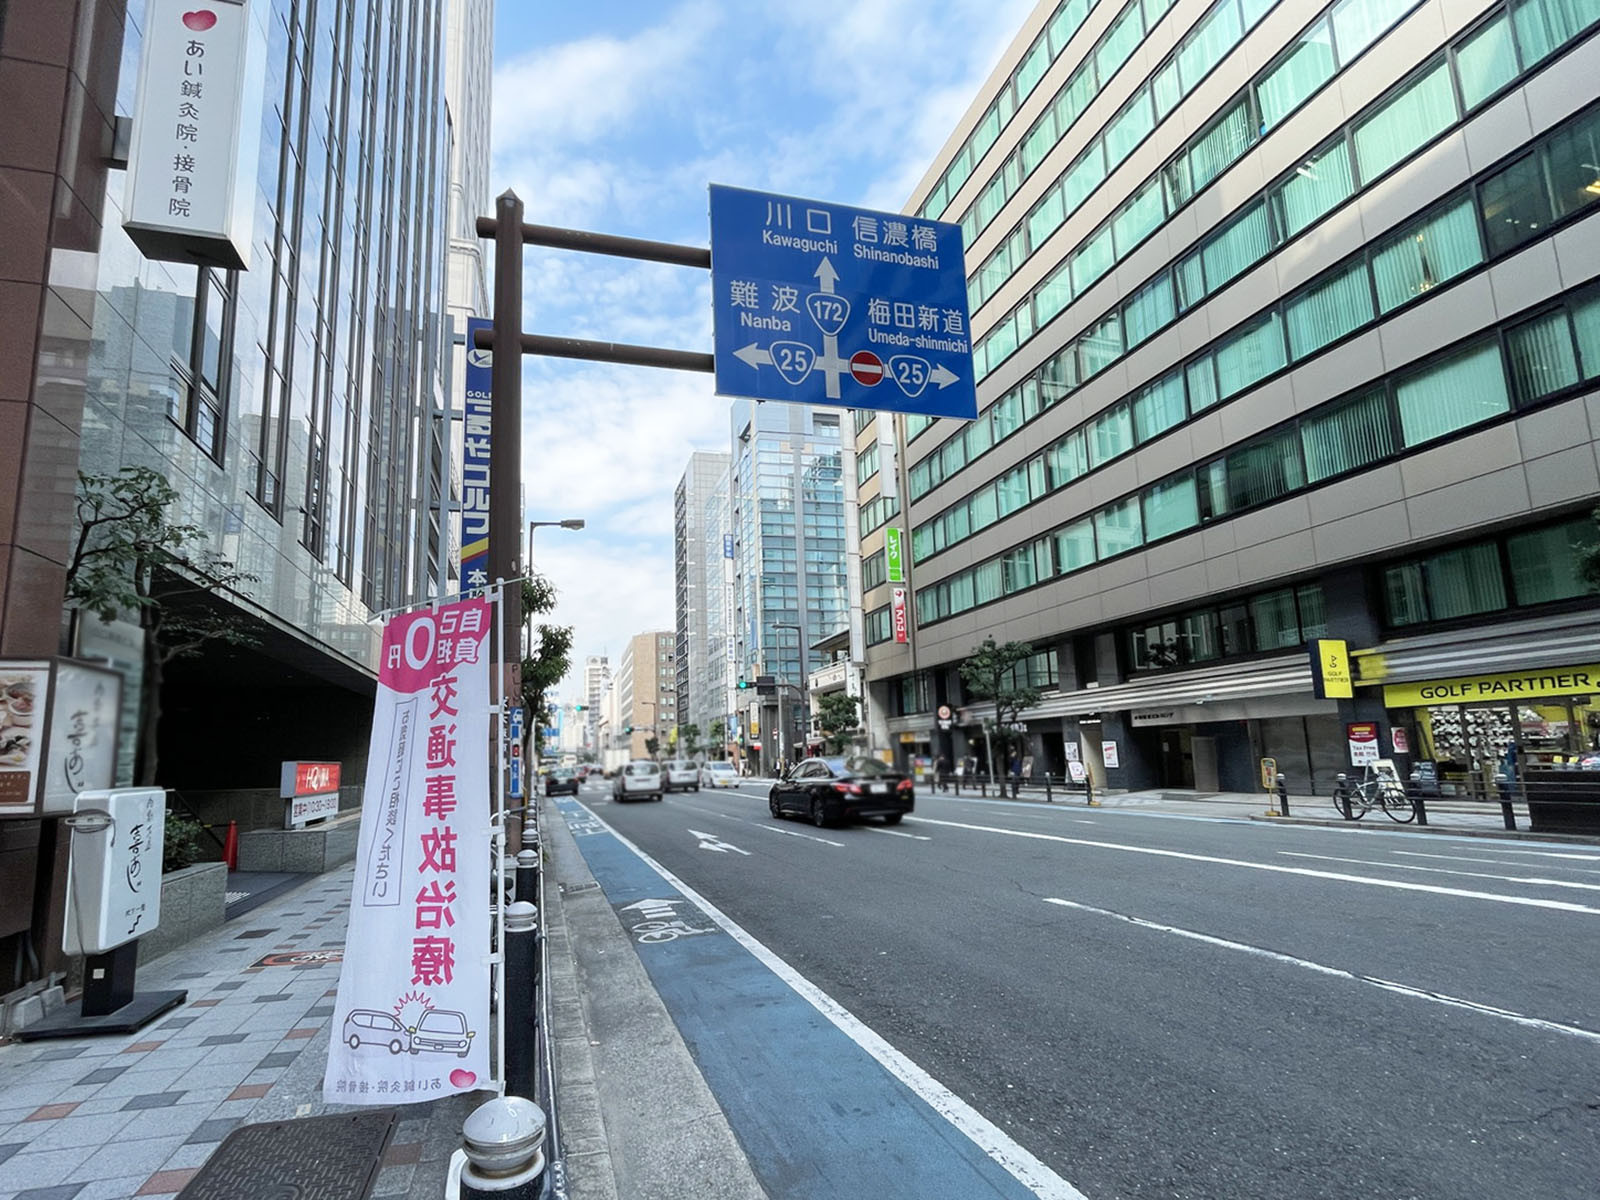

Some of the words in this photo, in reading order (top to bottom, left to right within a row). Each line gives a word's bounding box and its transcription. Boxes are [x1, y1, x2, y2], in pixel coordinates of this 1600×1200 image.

[168, 39, 206, 218] あい鍼灸院・接骨院
[765, 201, 832, 235] 川口
[852, 215, 938, 253] 信濃橋
[762, 230, 839, 255] Kawaguchi
[853, 243, 940, 270] Shinanobashi
[730, 280, 800, 314] 難波
[740, 311, 792, 332] Nanba
[814, 300, 844, 322] 172
[868, 297, 965, 336] 梅田新道
[868, 328, 969, 354] Umeda-shinmichi
[780, 349, 807, 372] 25
[898, 362, 924, 385] 25
[1420, 683, 1473, 699] GOLF
[1478, 673, 1591, 695] PARTNER
